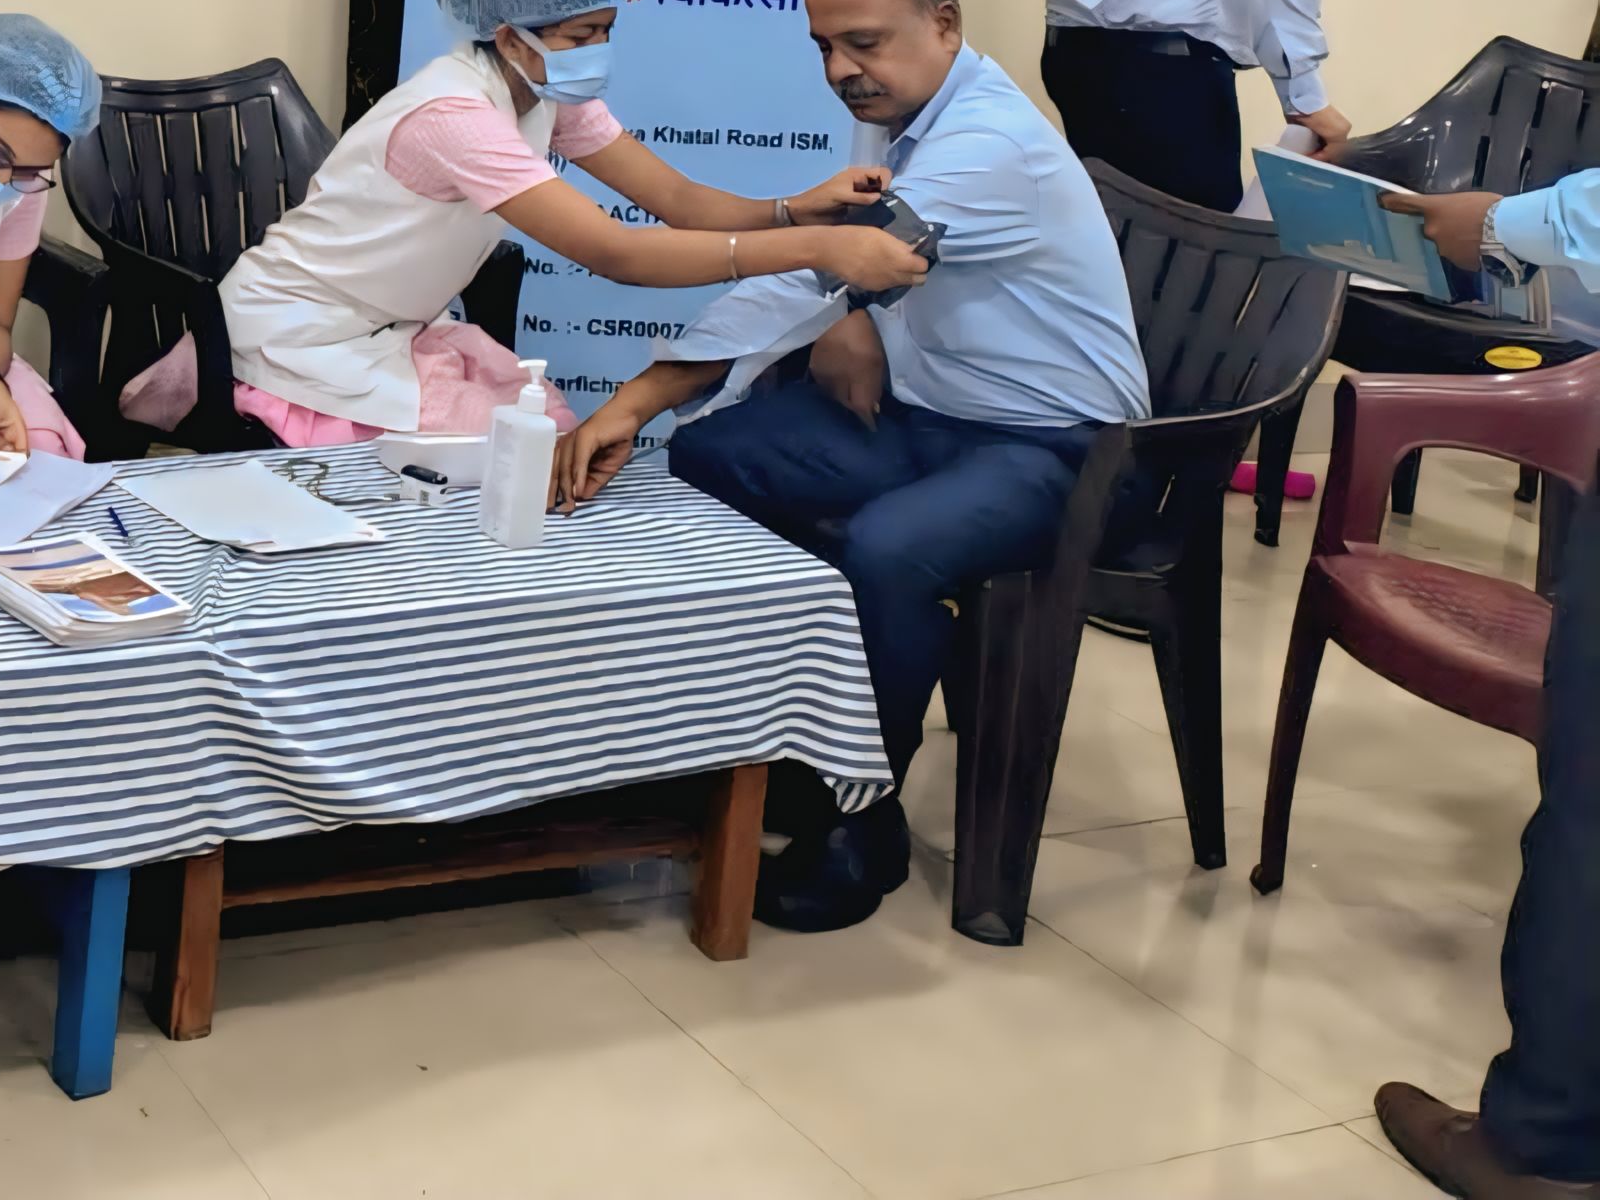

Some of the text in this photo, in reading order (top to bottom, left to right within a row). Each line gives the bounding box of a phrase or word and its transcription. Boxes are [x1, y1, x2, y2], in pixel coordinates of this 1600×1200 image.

[728, 130, 782, 147] Road
[790, 133, 833, 153] ISM,
[523, 314, 557, 333] No.
